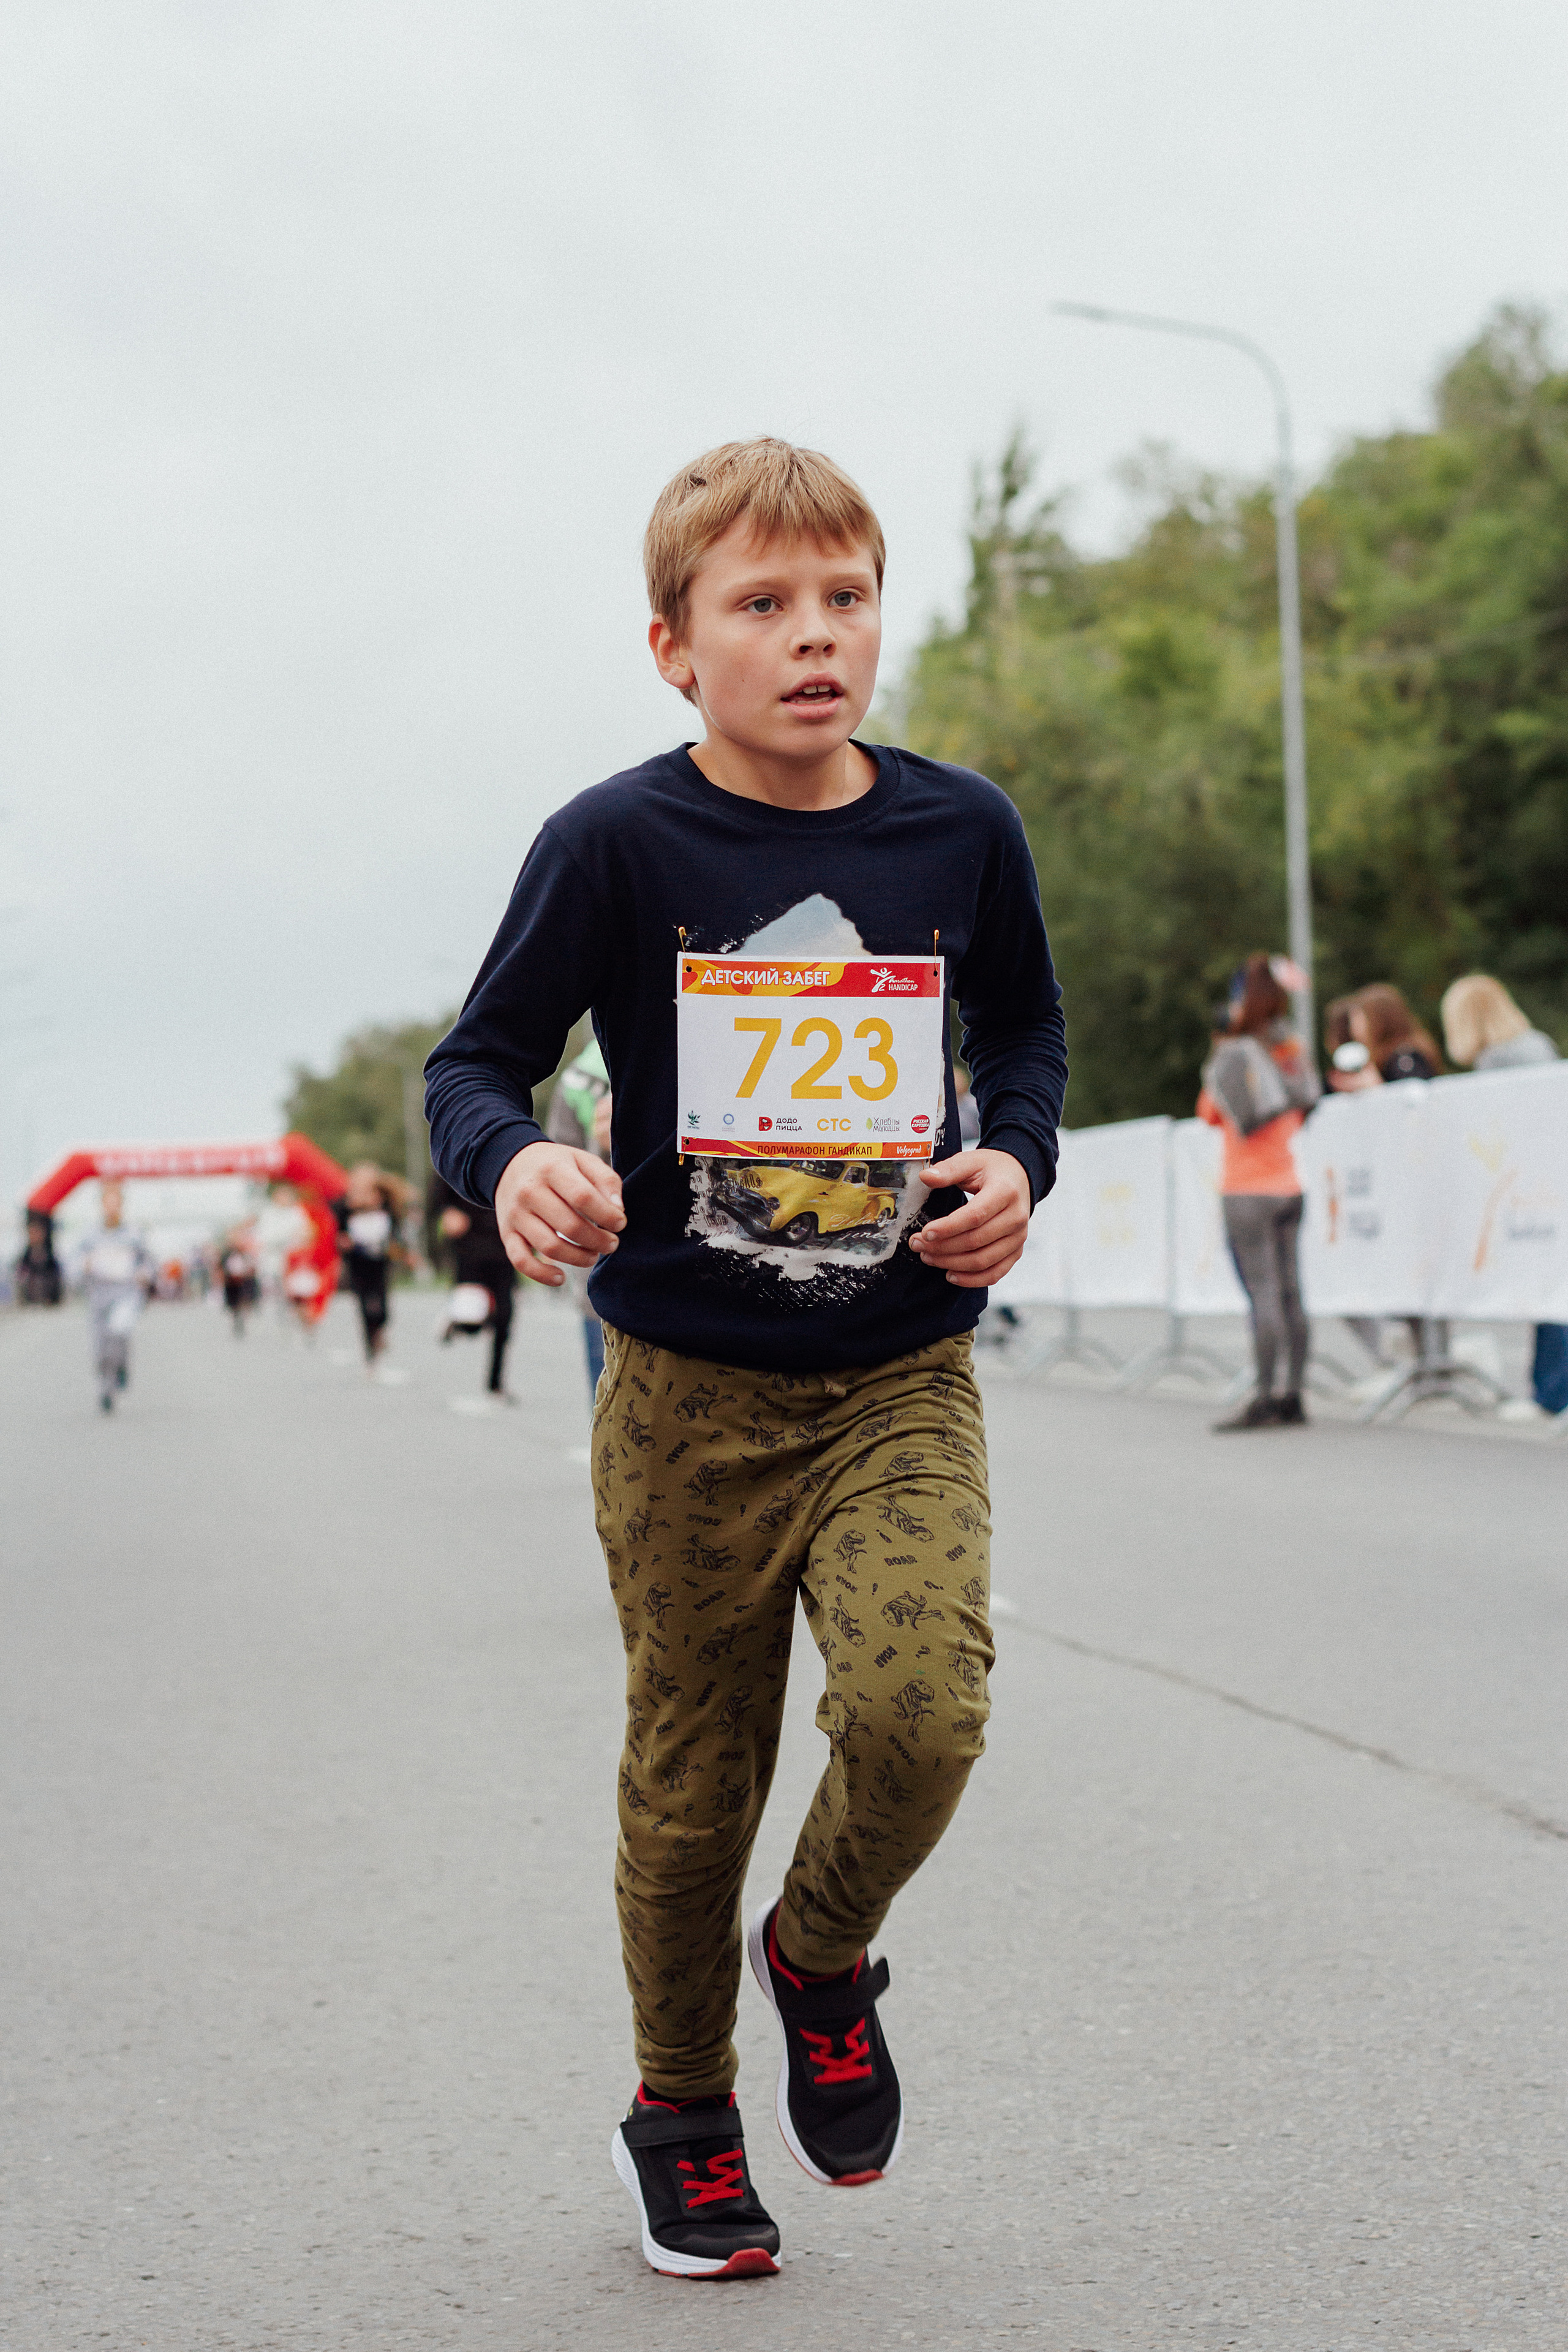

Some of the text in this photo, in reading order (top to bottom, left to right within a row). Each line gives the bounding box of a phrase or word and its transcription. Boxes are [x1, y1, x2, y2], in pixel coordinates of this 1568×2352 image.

[701, 968, 831, 986] ДЕТСКИЙ ЗАБЕГ
[734, 1017, 899, 1101] 723
[817, 1118, 851, 1131] СТС
[757, 1145, 872, 1156] ПОЛУМАРАФОН ГАНДИКАП
[897, 1145, 922, 1156] Volgograd
[665, 1440, 690, 1464] ROAR
[753, 1548, 777, 1572] ROAR
[884, 1555, 918, 1566] ROAR
[945, 1544, 967, 1561] ROAR
[835, 1575, 858, 1594] ROAR
[693, 1590, 726, 1611] ROAR
[874, 1645, 897, 1668] ROAR
[837, 1662, 853, 1672] OAR
[696, 1681, 717, 1707] ROAR
